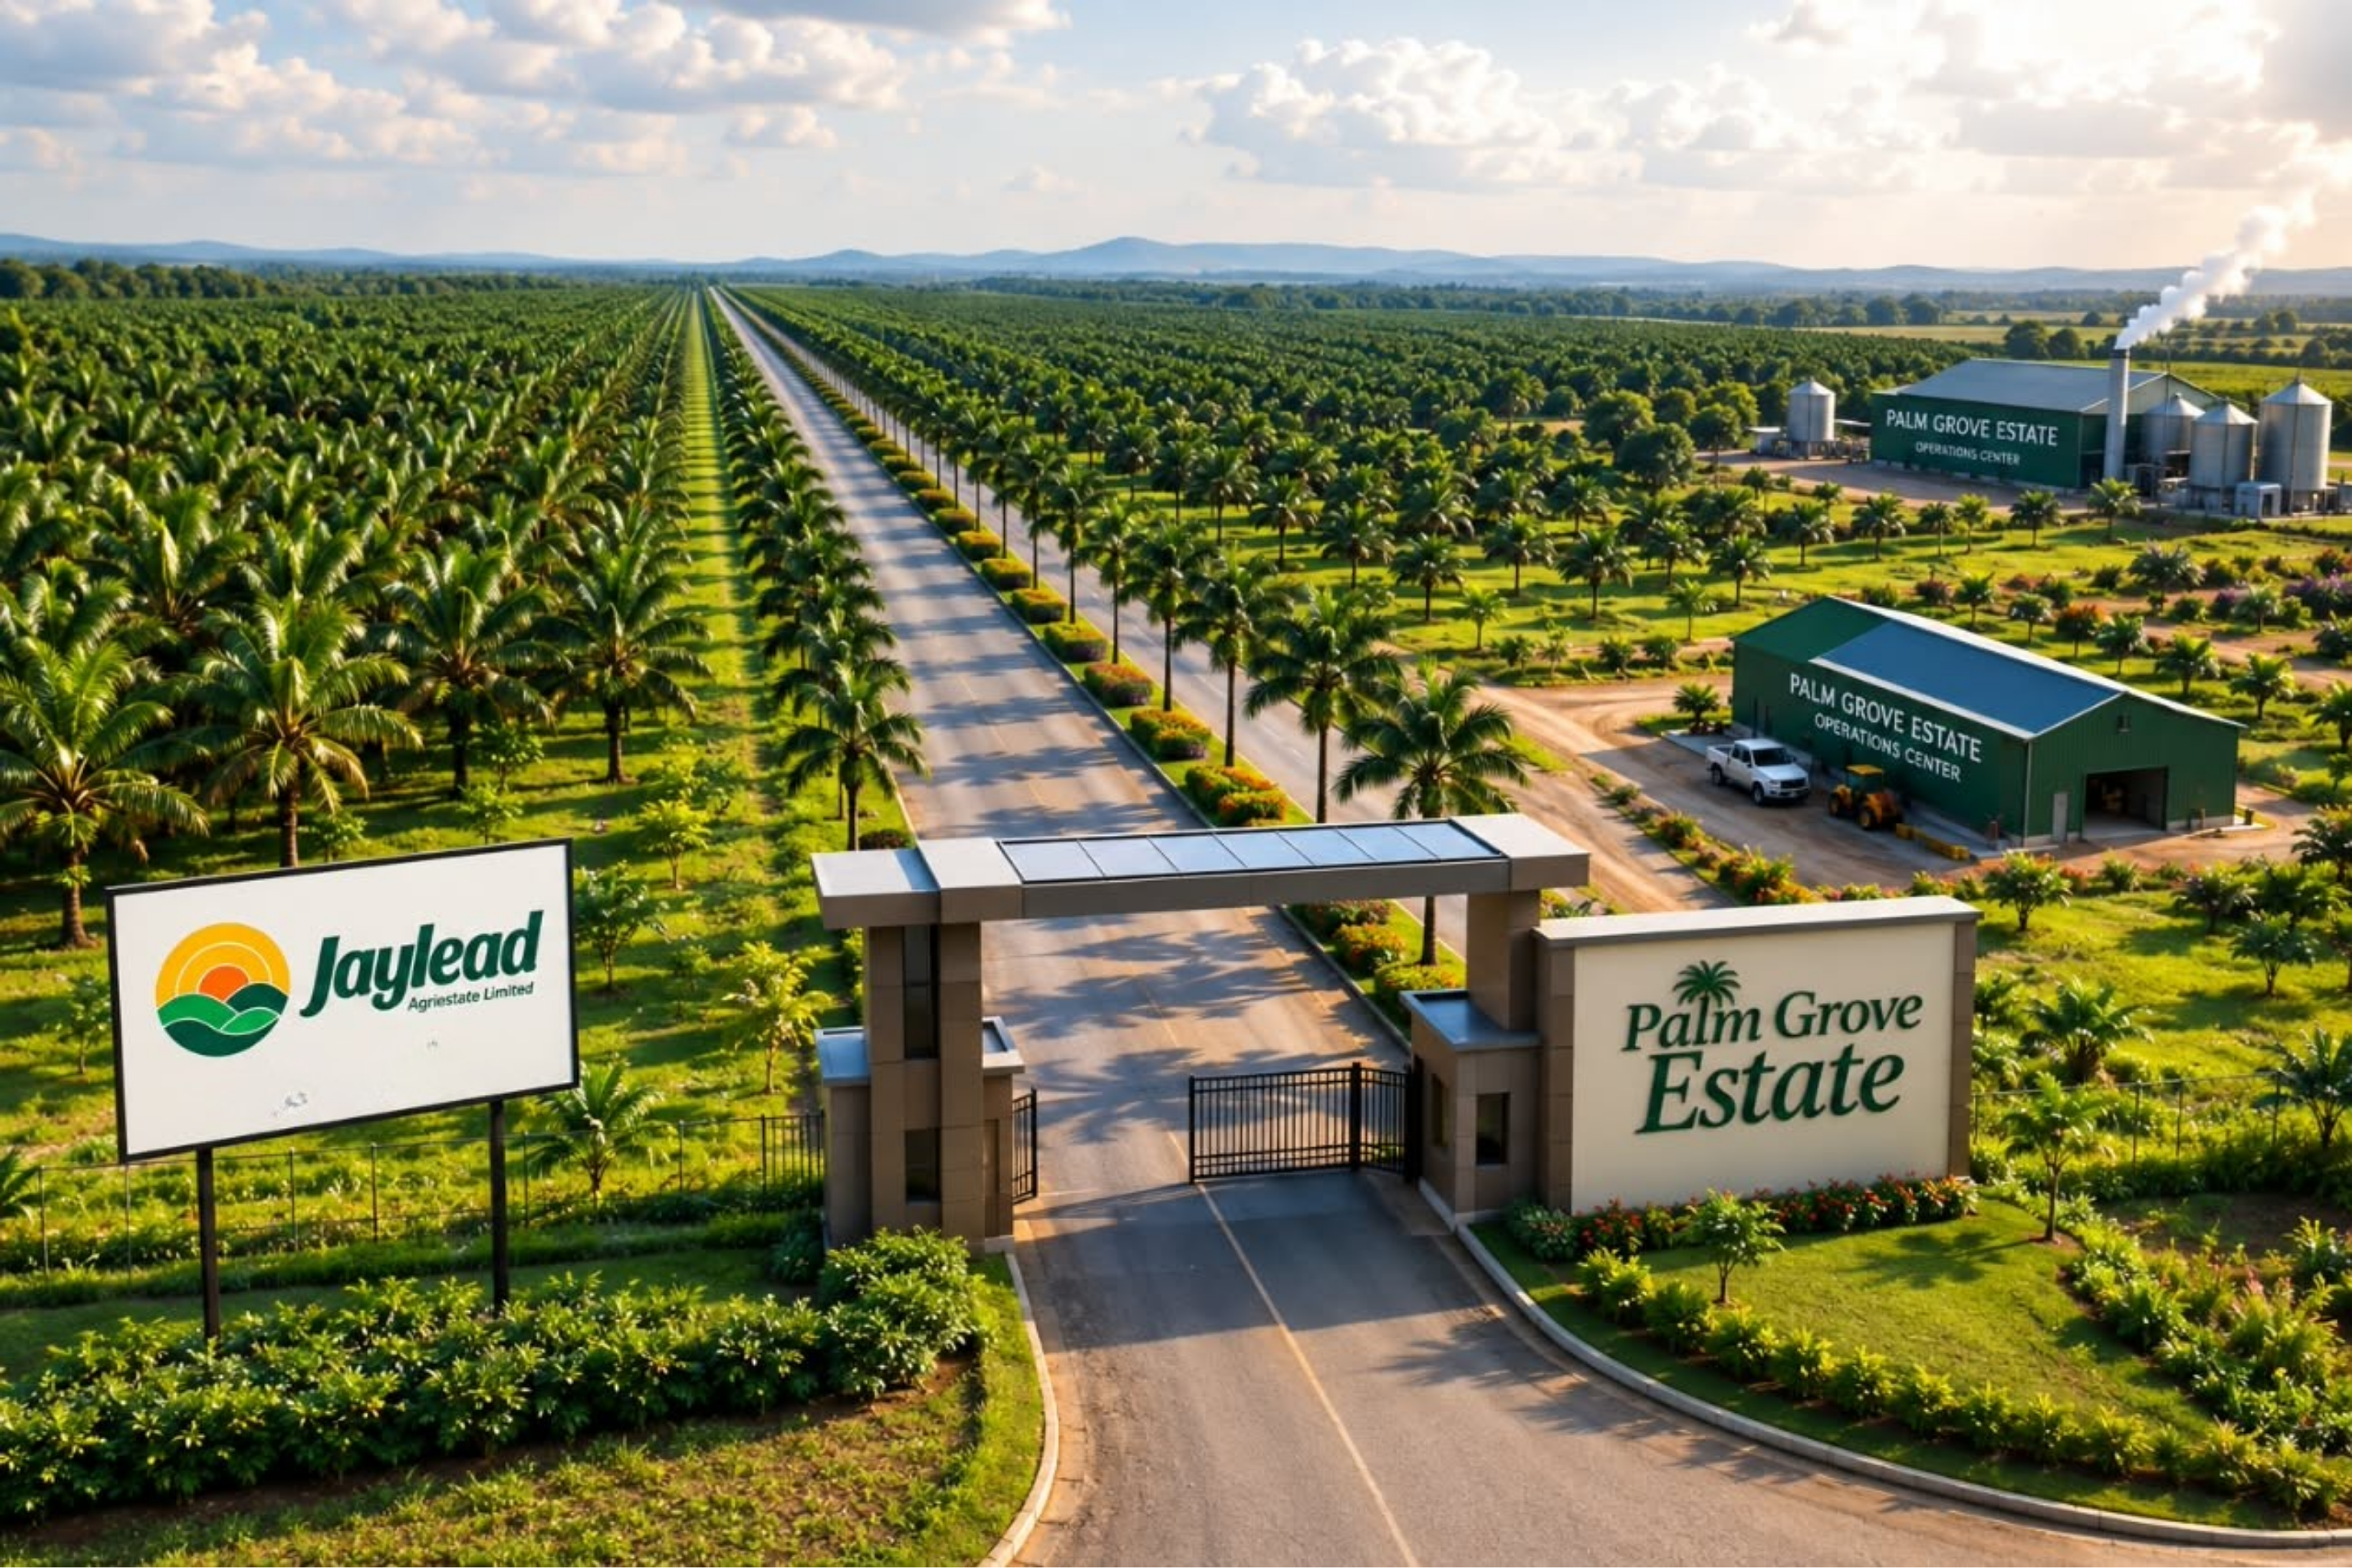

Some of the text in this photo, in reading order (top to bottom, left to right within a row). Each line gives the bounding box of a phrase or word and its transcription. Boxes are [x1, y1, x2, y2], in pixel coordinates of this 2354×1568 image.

[1887, 409, 2058, 446] PALM GROVE ESTATE
[1915, 442, 2020, 465] OPERATIONS CENTER
[1790, 673, 1982, 763] PALM GROVE ESTATE
[1814, 713, 1961, 782] OPERATIONS CENTER
[299, 910, 544, 1018] Jaylead
[407, 981, 534, 1013] Agriestate Limited
[1621, 990, 1924, 1053] Palm Grove
[1634, 1042, 1905, 1135] Estate
